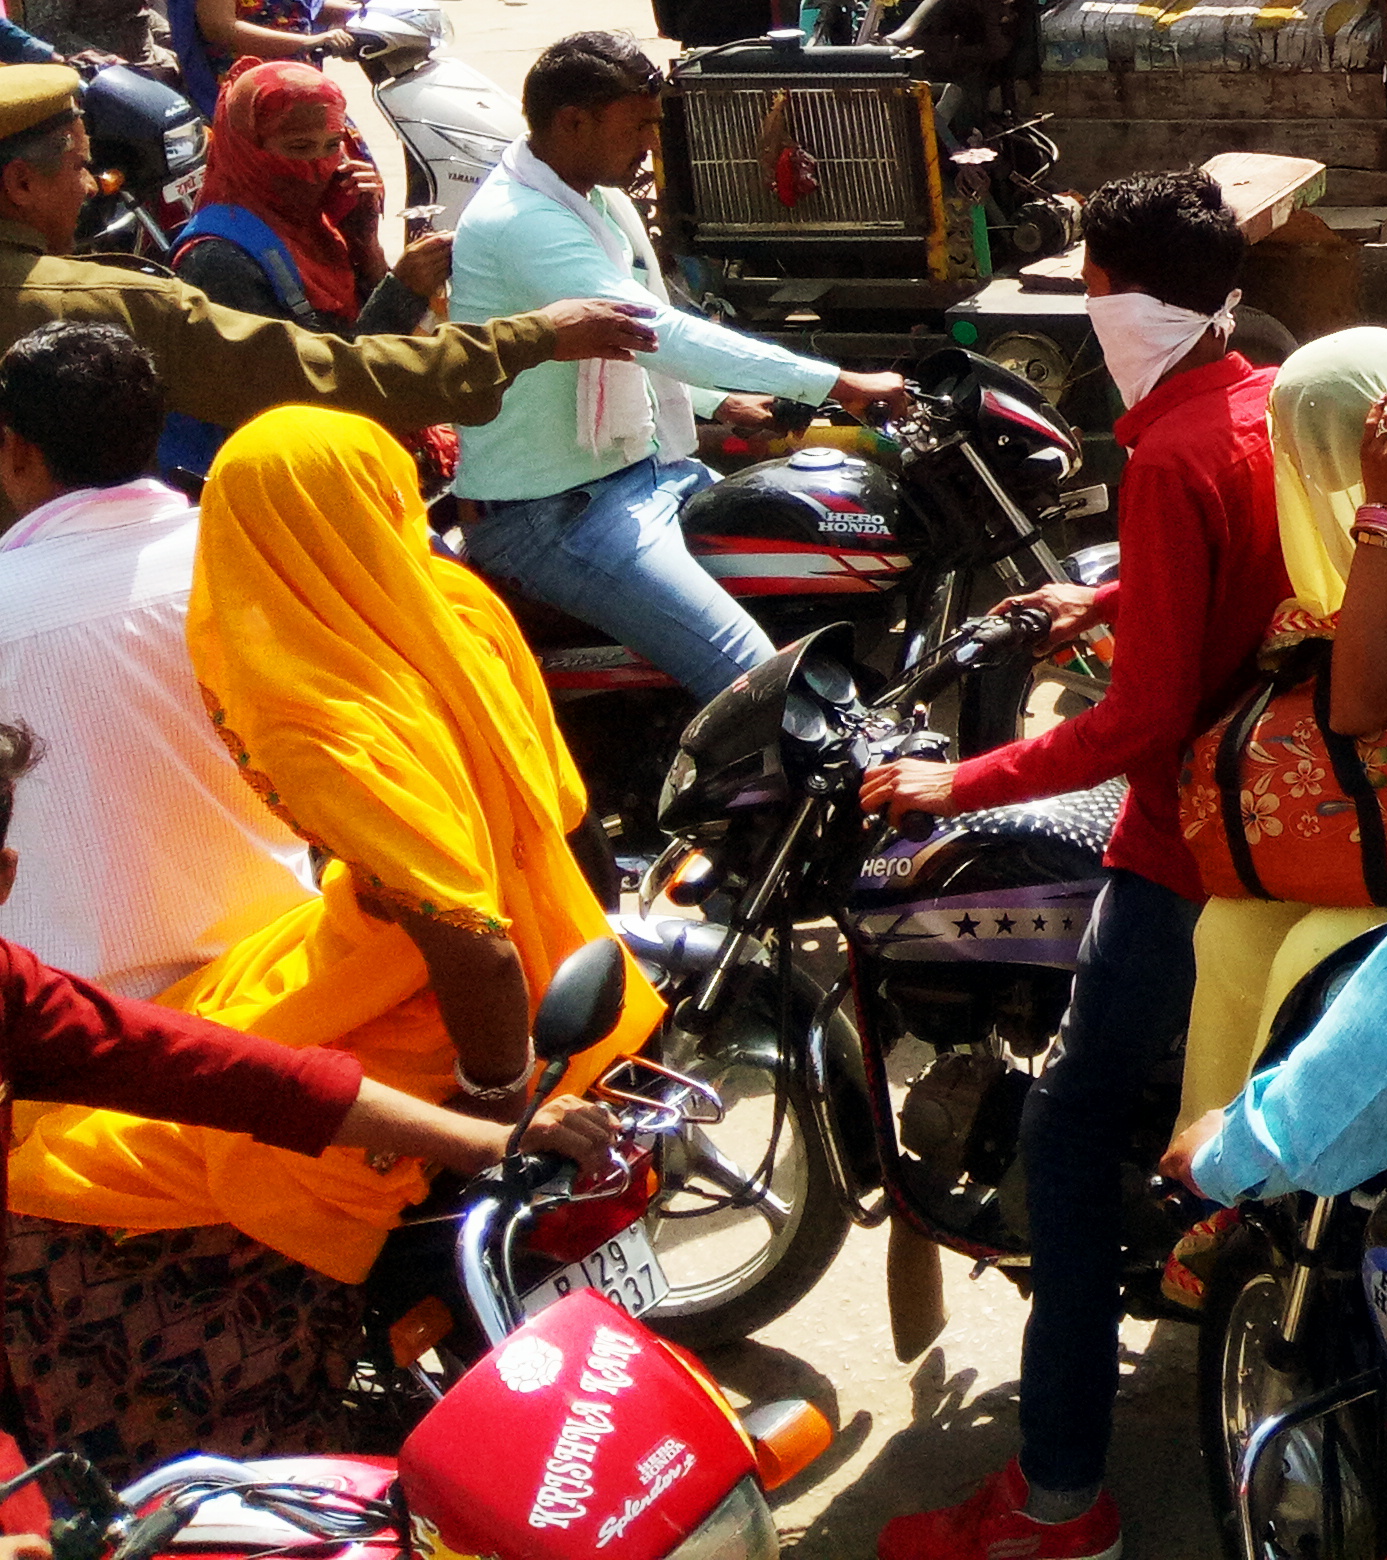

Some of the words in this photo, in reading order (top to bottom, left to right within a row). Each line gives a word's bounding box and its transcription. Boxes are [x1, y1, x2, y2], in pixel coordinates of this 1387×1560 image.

[818, 521, 892, 536] HONDA
[827, 512, 885, 525] HERO
[529, 1401, 615, 1530] KRISHNA
[637, 1438, 677, 1477] HERO
[640, 1441, 688, 1486] HONDA
